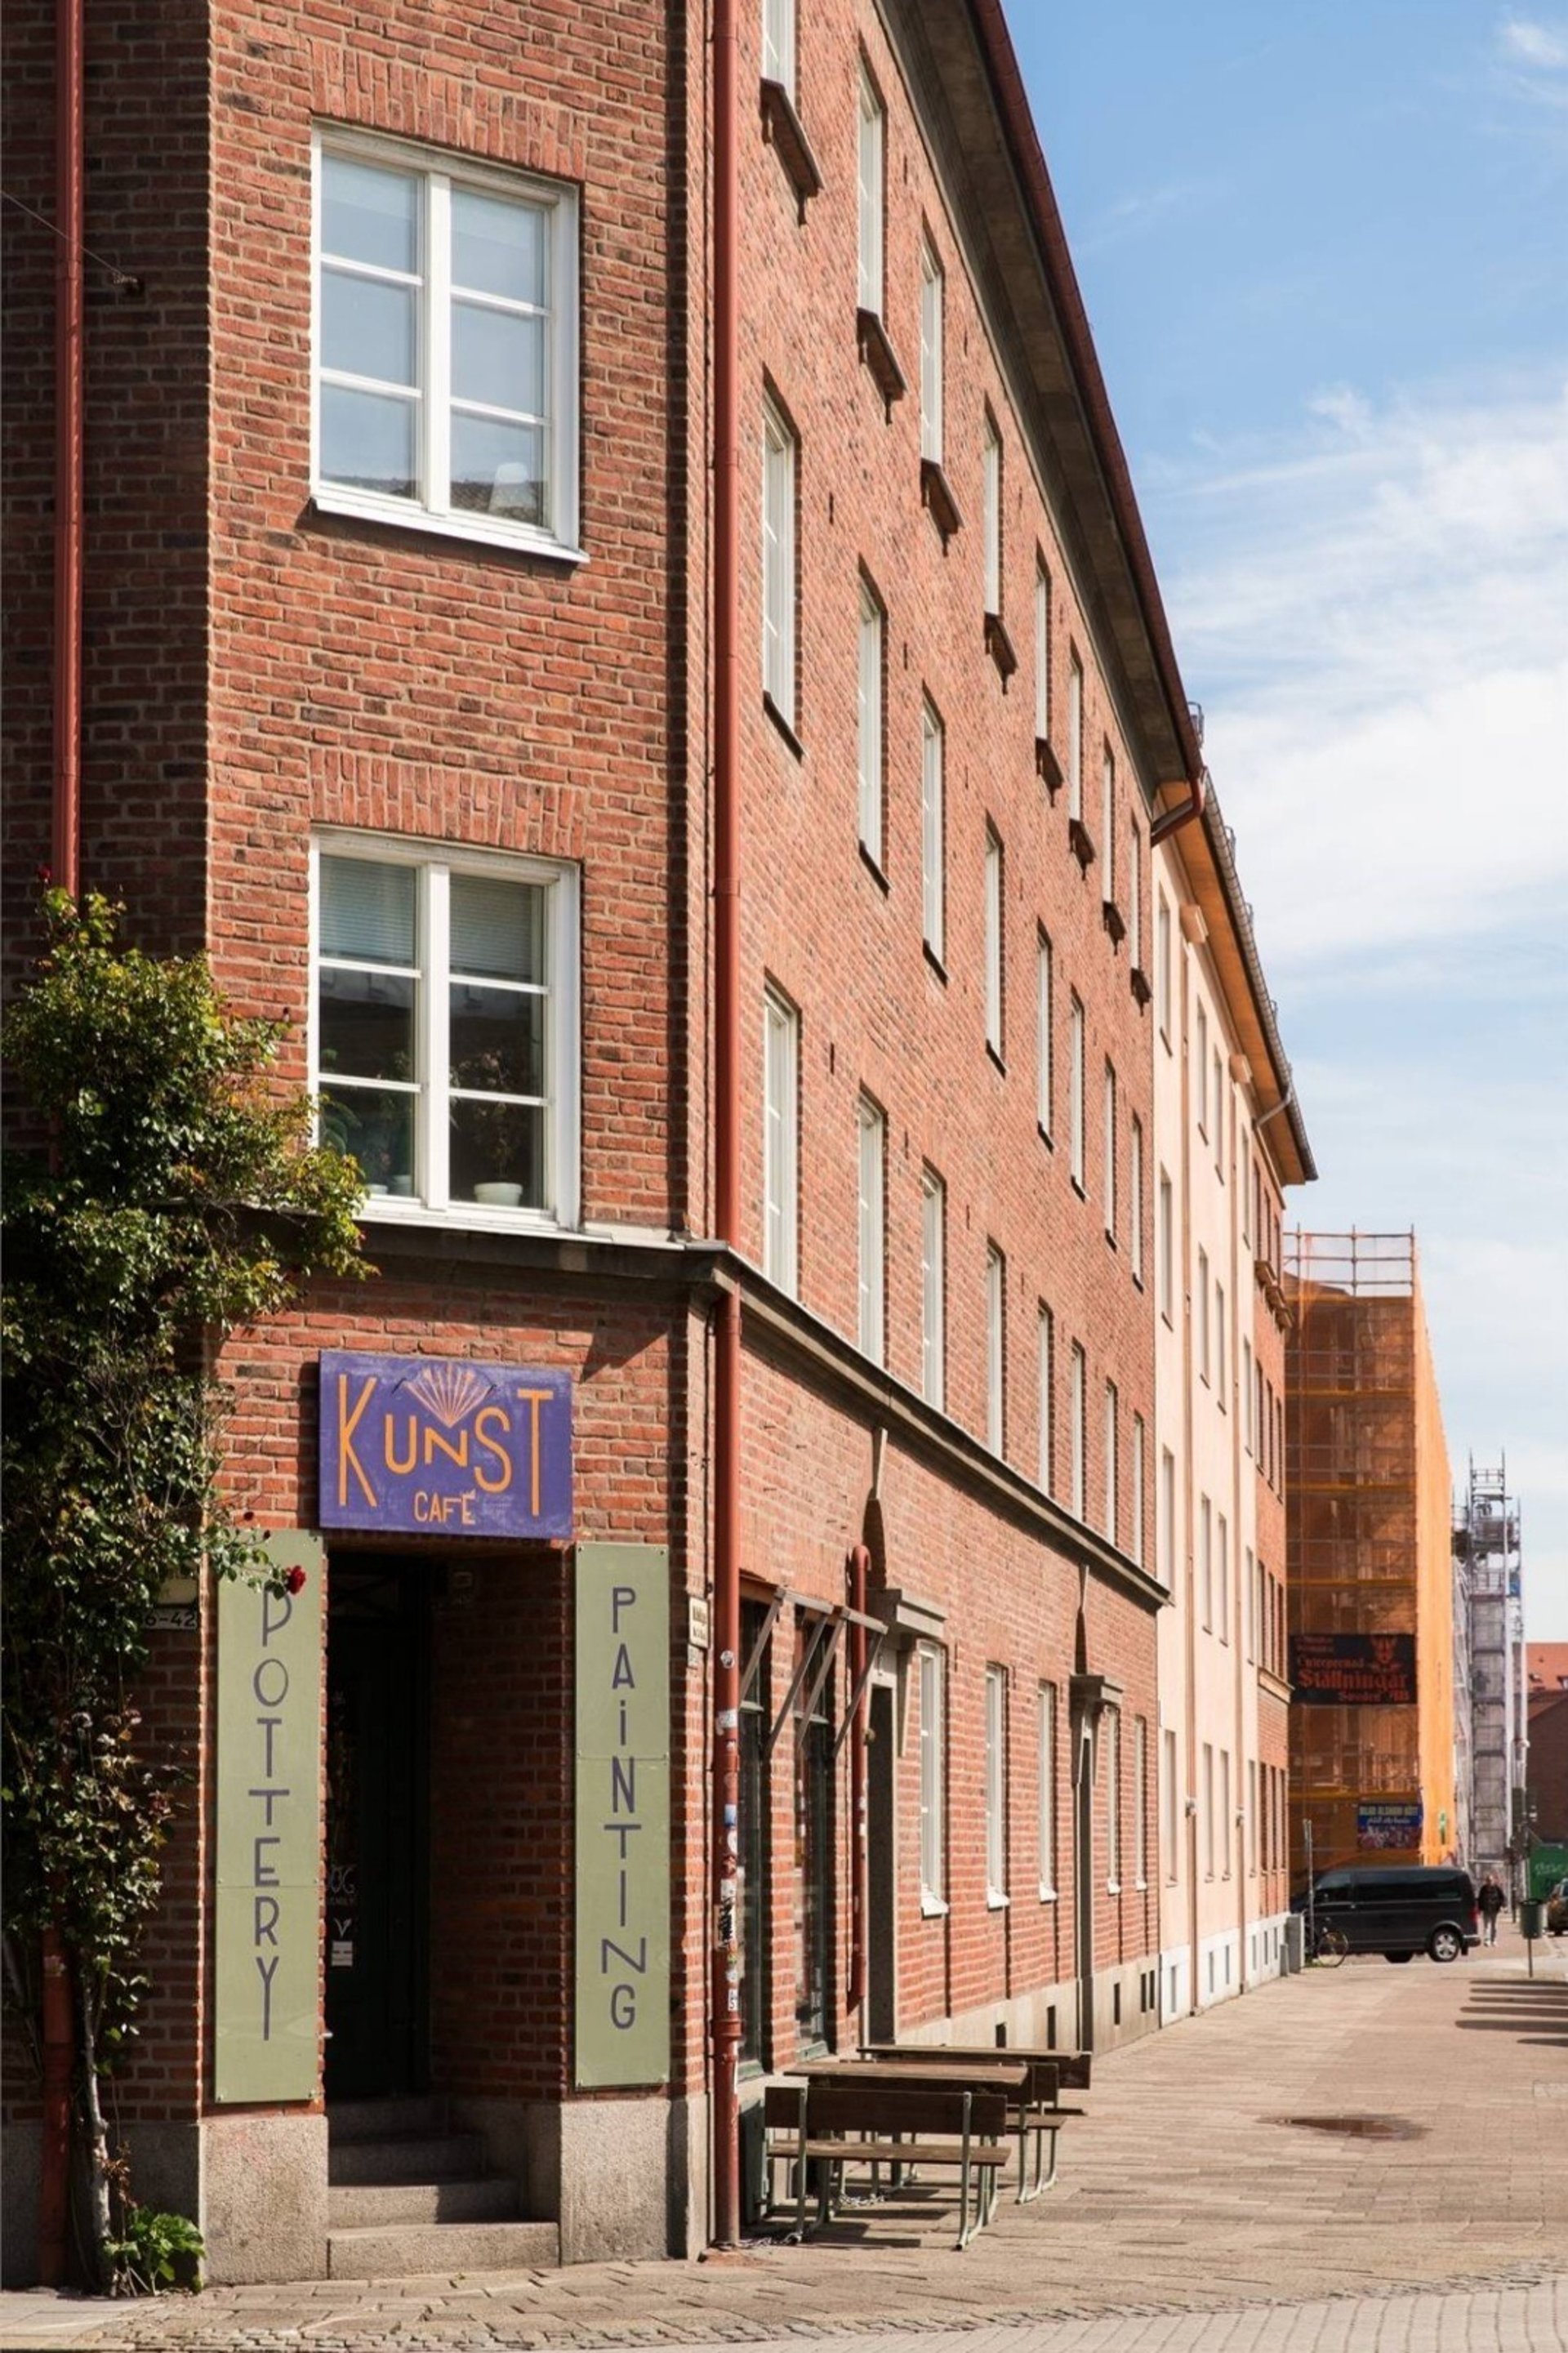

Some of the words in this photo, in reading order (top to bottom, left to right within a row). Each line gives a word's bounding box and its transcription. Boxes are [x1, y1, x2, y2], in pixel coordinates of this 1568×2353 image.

[338, 1373, 555, 1517] KUNST
[137, 1611, 196, 1628] 6-42
[248, 1583, 293, 2042] POTTERY
